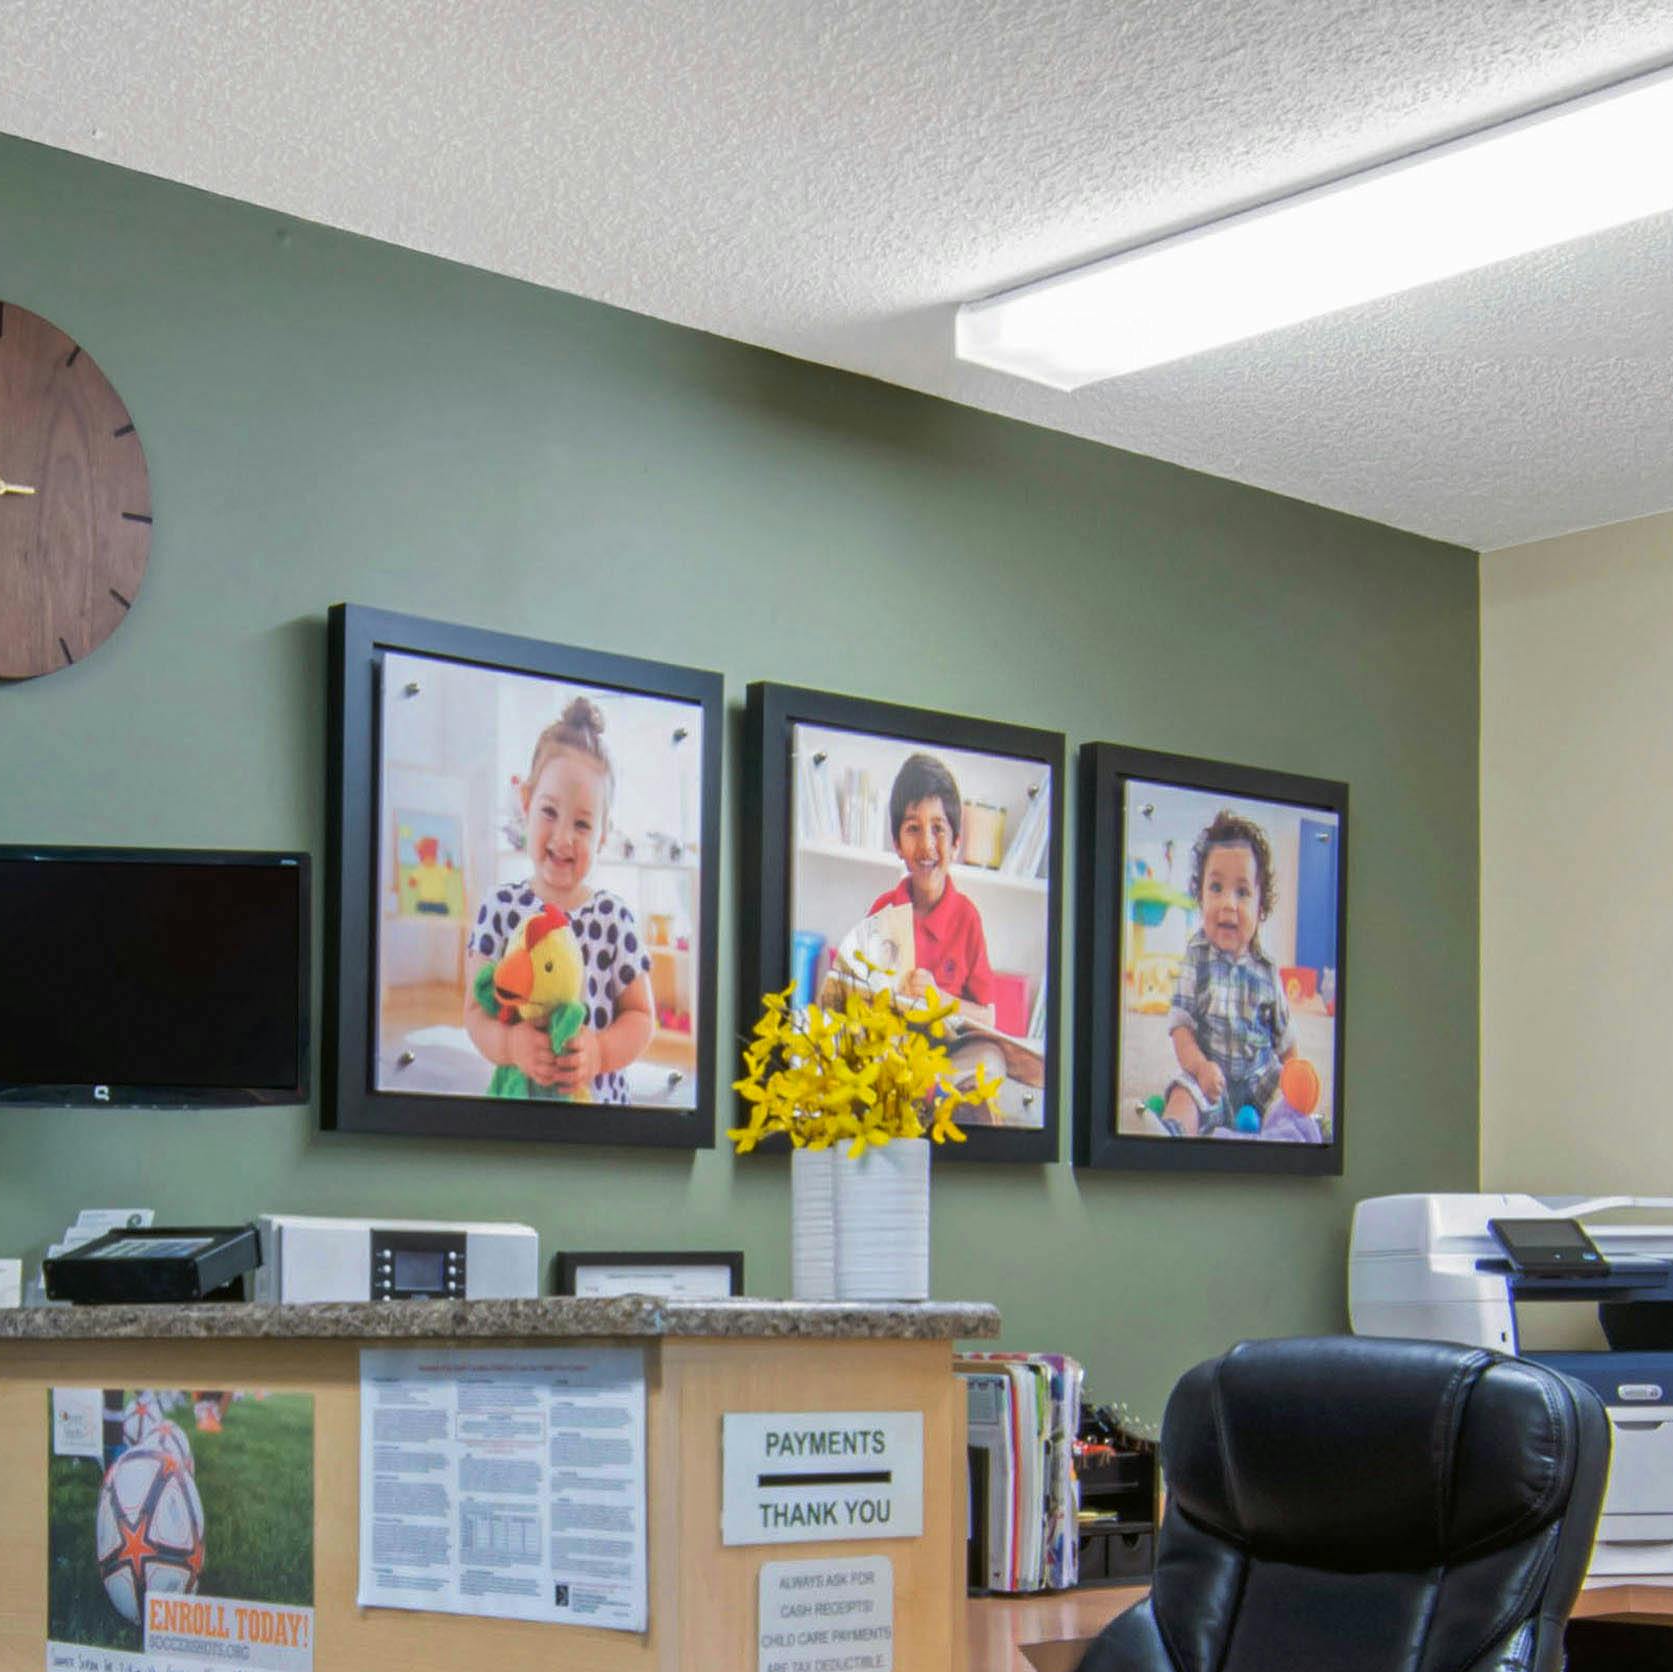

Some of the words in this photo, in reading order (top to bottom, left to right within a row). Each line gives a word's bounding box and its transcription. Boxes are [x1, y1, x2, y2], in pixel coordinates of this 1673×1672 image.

[765, 1430, 886, 1456] PAYMENTS
[759, 1501, 838, 1528] THANK
[844, 1499, 891, 1525] YOU
[779, 1574, 824, 1590] ALWAYS
[826, 1572, 848, 1587] ASK
[850, 1570, 875, 1586] FOR
[780, 1602, 812, 1618] CASH
[149, 1598, 230, 1640] ENROLL
[235, 1607, 310, 1649] TODAY!
[761, 1632, 796, 1649] CHILD
[797, 1630, 829, 1646] CARE
[831, 1625, 892, 1642] PAYMENTS
[814, 1654, 884, 1672] DEDUCTIBLE
